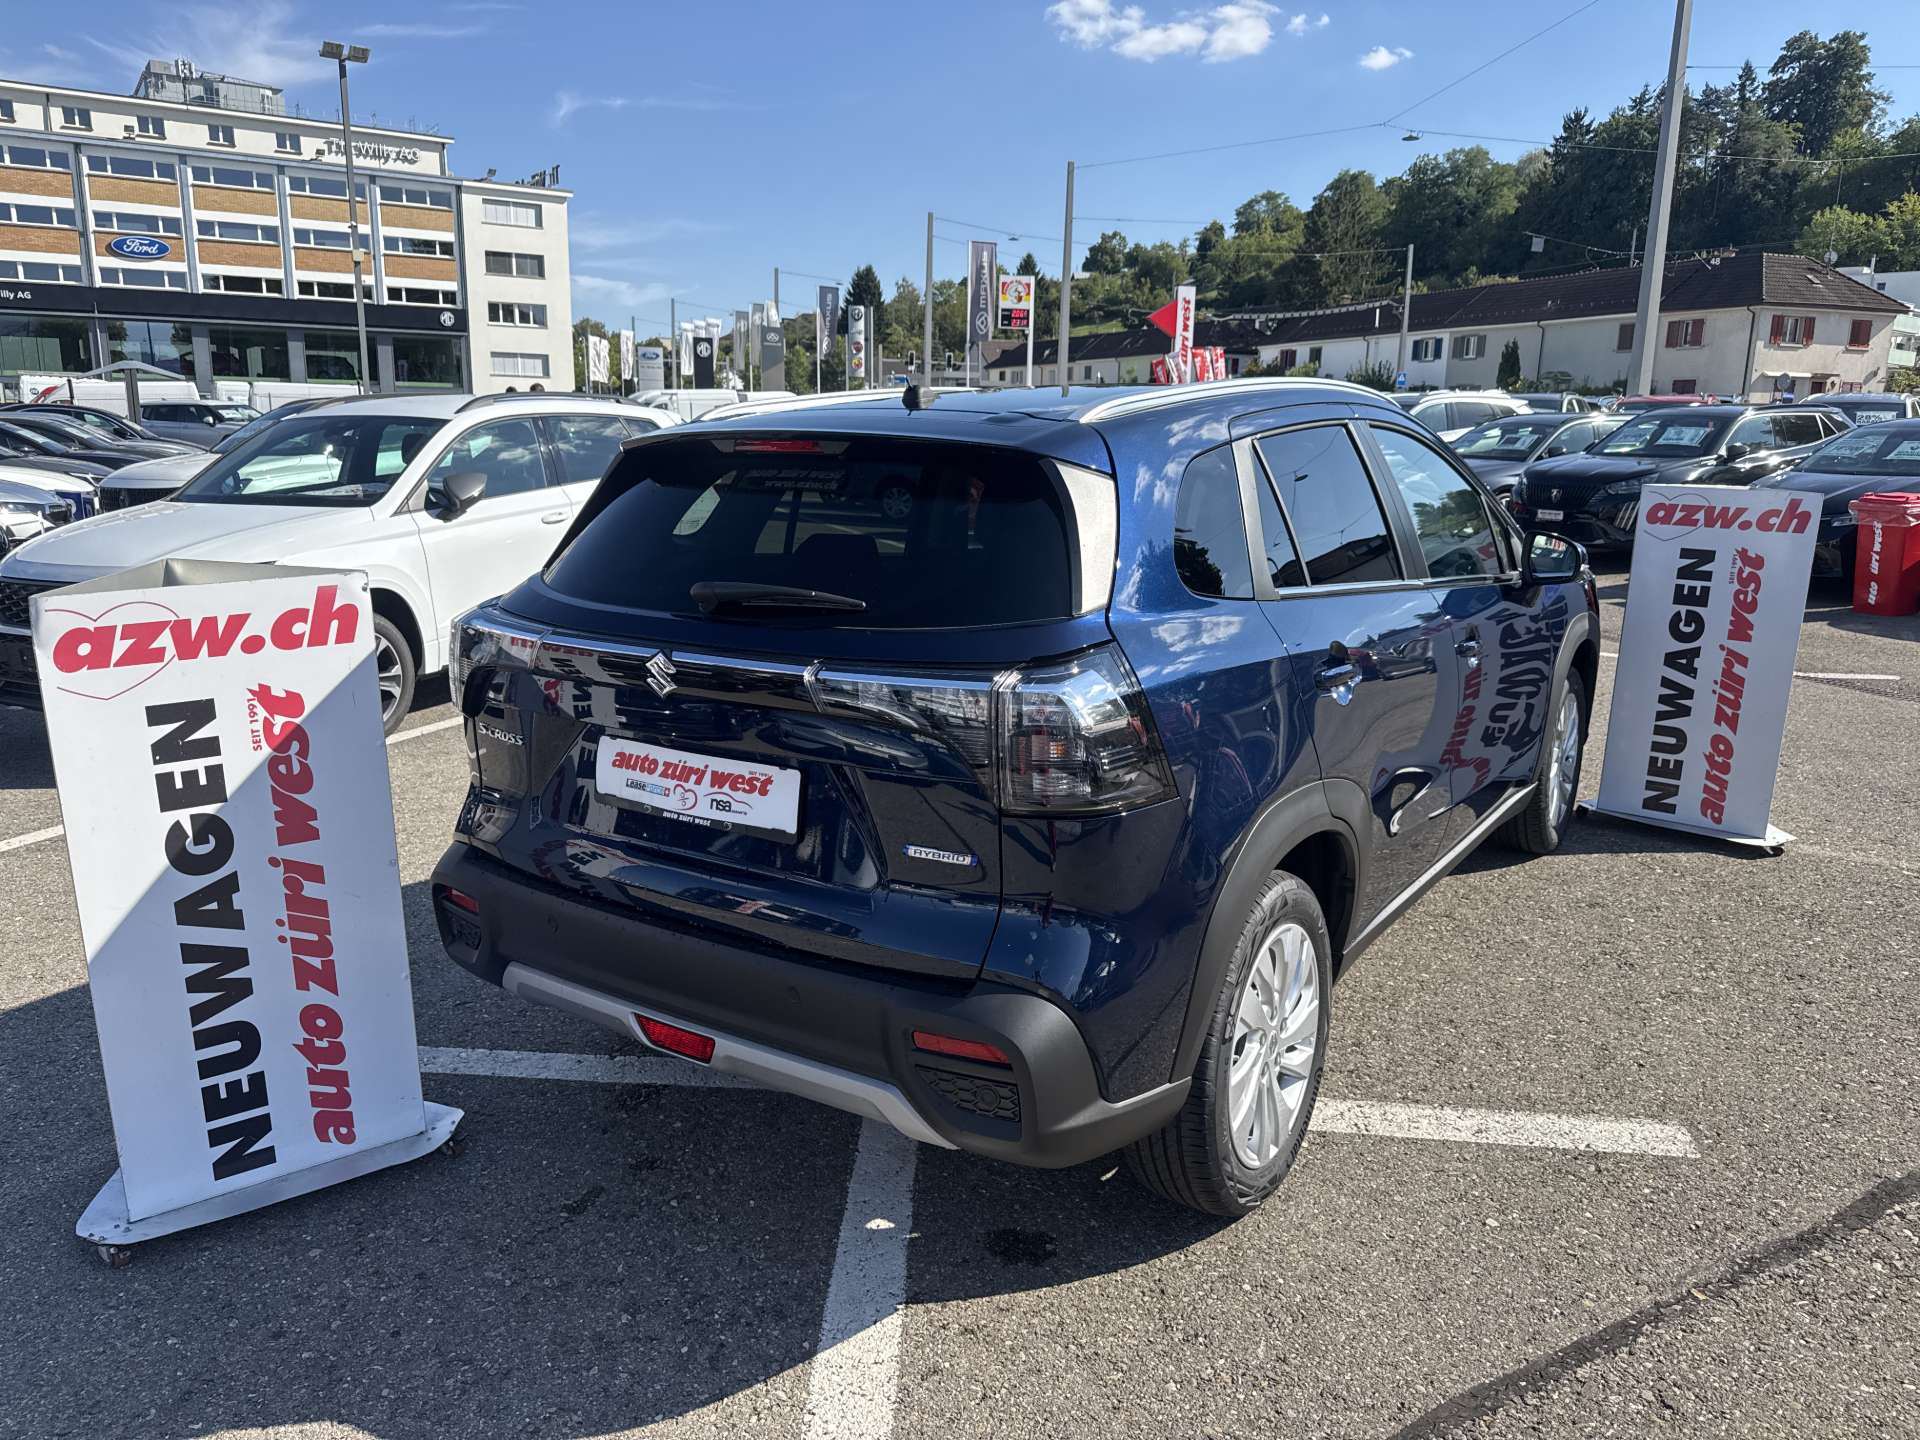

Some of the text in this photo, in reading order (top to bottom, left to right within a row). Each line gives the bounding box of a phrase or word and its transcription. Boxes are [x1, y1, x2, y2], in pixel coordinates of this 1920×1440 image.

[123, 239, 159, 254] Ford
[0, 289, 32, 300] illy AG
[1646, 499, 1811, 534] azw.ch
[53, 585, 359, 673] azw.ch
[1642, 548, 1716, 815] NEUWAGEN
[1700, 547, 1765, 825] auto züri west
[247, 697, 262, 752] SEIT 1991
[612, 751, 775, 797] auto züri west
[662, 810, 679, 820] auto
[694, 817, 712, 827] west
[709, 797, 732, 812] nsa
[913, 848, 967, 863] HYBRID
[246, 683, 357, 1145] auto züri west
[145, 698, 276, 1181] NEUWAGEN
